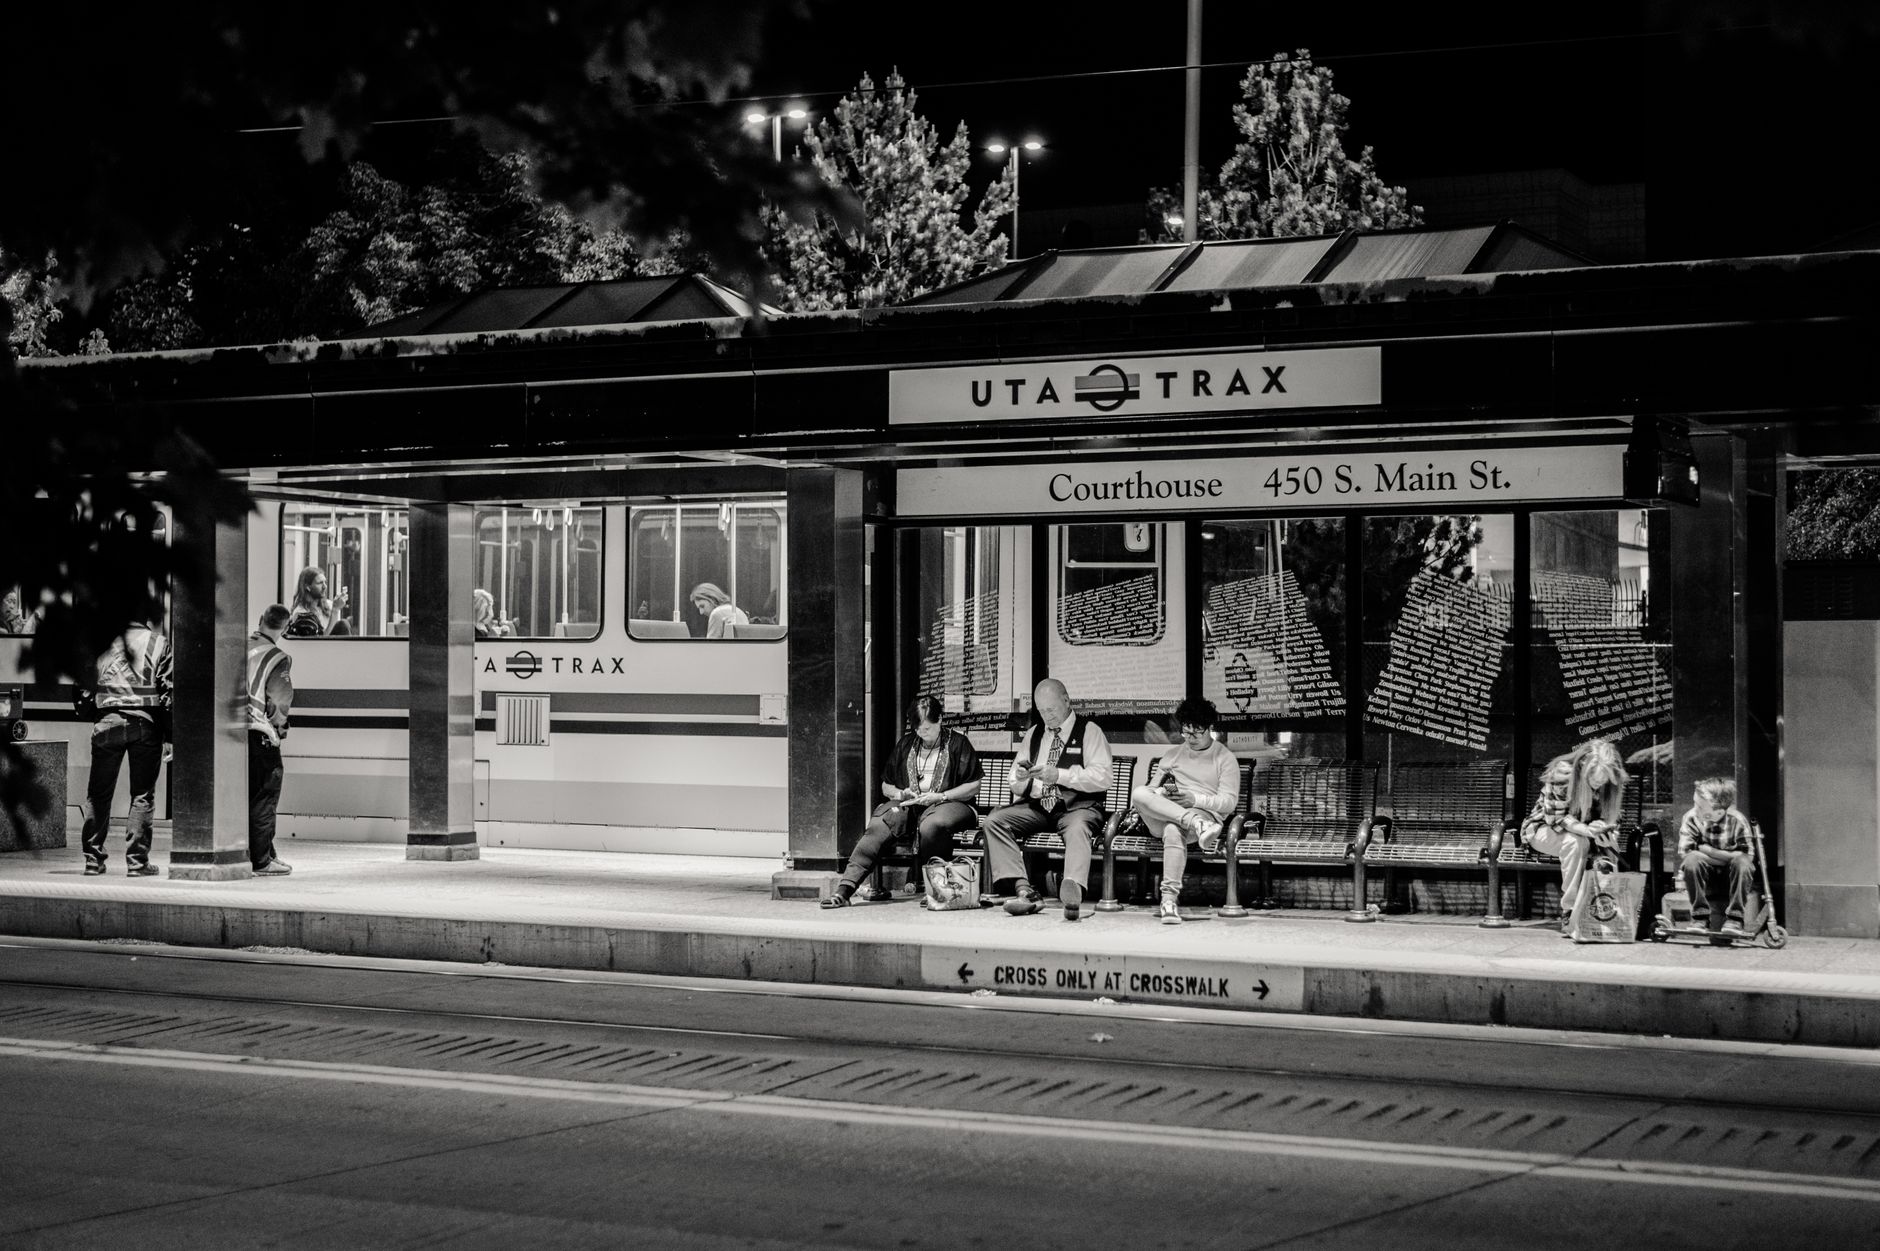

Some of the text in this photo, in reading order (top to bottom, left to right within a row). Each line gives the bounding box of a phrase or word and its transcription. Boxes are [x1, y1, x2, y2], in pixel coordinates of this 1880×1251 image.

[971, 365, 1289, 408] UTA TRAX
[1049, 460, 1512, 504] Courthouse 450 S. Main St.
[552, 657, 625, 674] TRAX
[994, 965, 1230, 998] CROSS ONLY AT CROSSWALK
